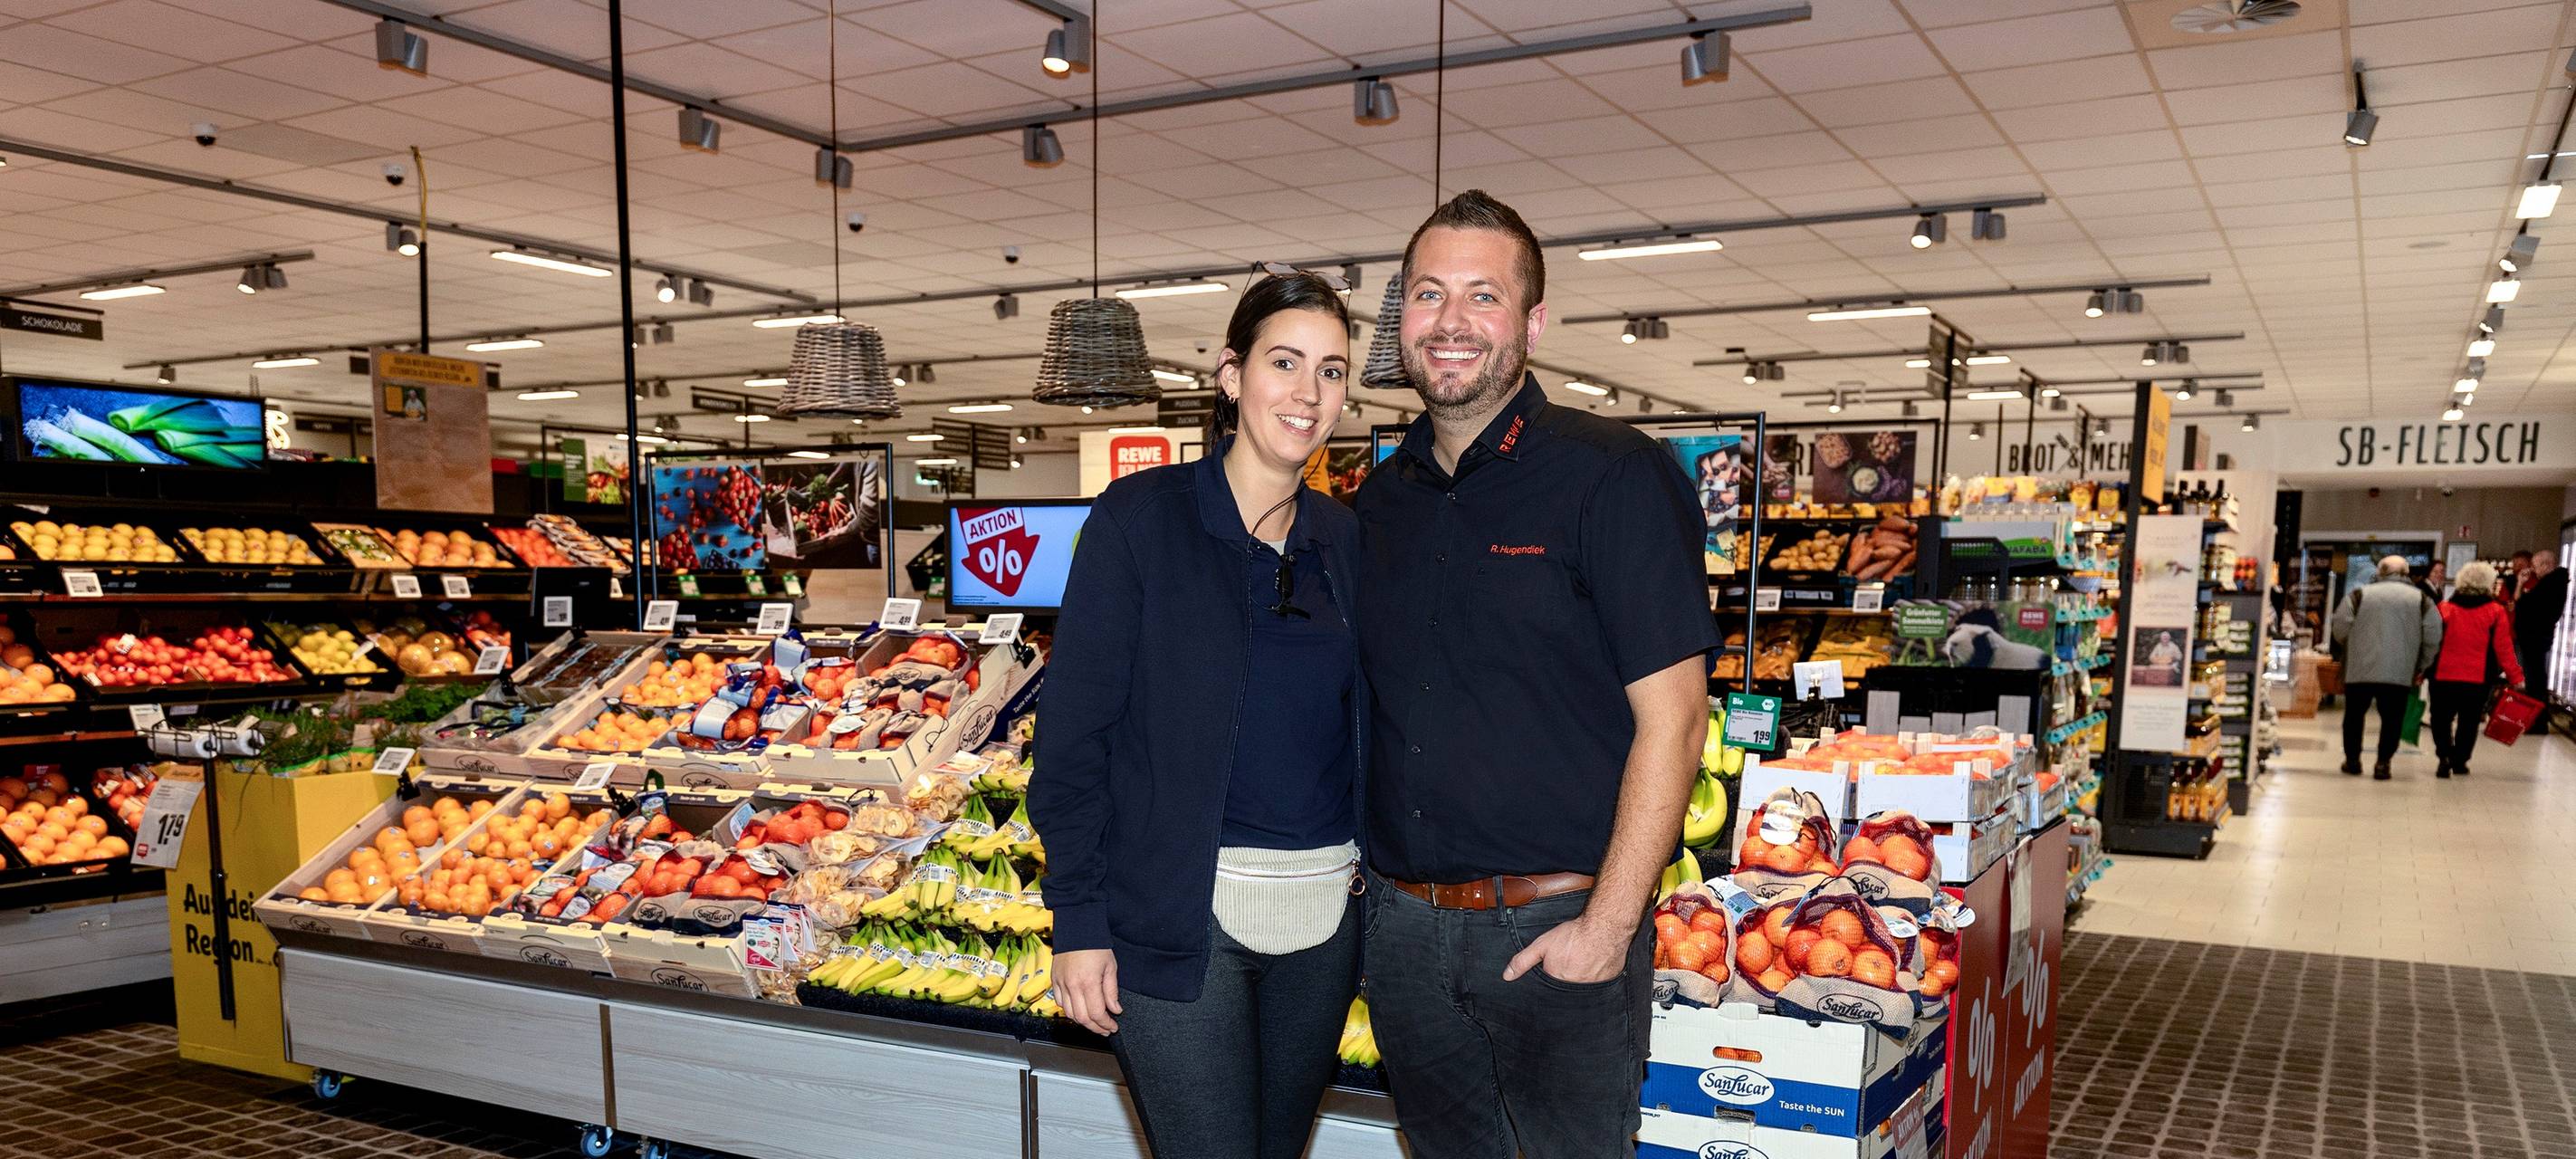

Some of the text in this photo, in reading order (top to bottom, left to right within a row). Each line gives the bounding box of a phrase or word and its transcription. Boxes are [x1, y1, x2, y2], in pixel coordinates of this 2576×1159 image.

[22, 315, 83, 333] SCHOKOLADE
[1499, 415, 1524, 452] REWE
[2336, 421, 2540, 466] SB-FLEISCH
[1118, 446, 1162, 463] REWE
[2008, 444, 2056, 472] BROT
[2091, 442, 2134, 471] MEH
[969, 509, 1017, 539] AKTION
[979, 539, 1023, 584] %
[1490, 545, 1545, 556] R. Hugendiek
[1732, 697, 1743, 705] Bio
[961, 709, 993, 748] SanLucar
[1753, 730, 1771, 743] 1.99
[158, 813, 185, 845] 1.79
[697, 909, 733, 924] SanLucar
[657, 972, 704, 991] SanLucar
[1822, 997, 1879, 1021] SanLucar
[1968, 977, 1996, 1114] %
[1704, 1073, 1769, 1097] SanLucar
[2014, 1044, 2045, 1121] AKTION
[1779, 1100, 1845, 1116] Taste the SUN
